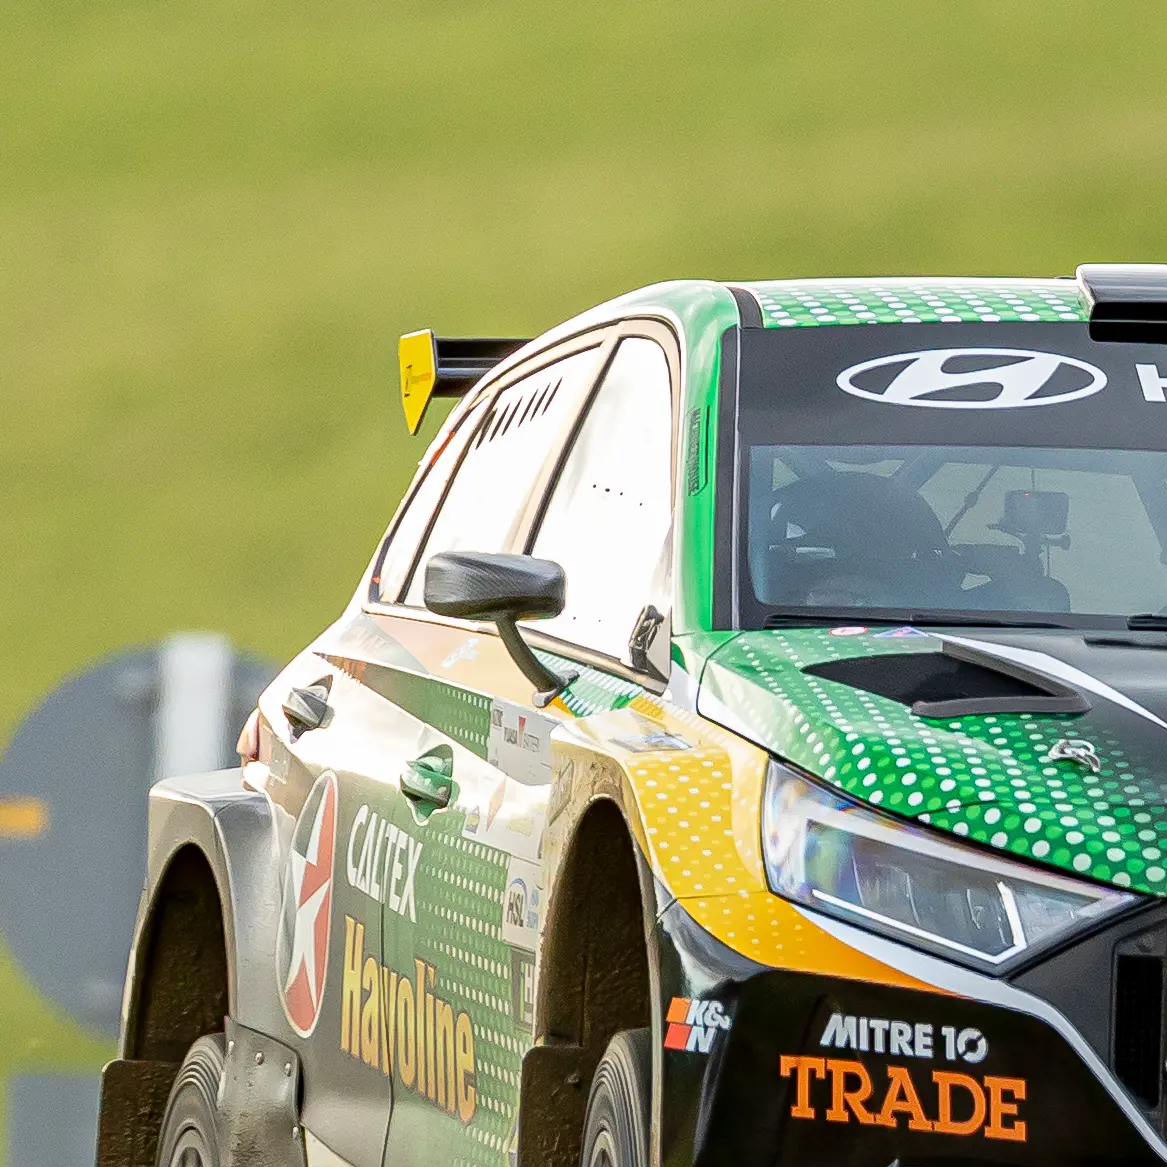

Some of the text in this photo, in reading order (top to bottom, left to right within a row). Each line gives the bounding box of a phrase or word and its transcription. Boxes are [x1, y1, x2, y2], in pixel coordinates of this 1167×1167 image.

[346, 804, 424, 924] CALTEX
[340, 914, 477, 1125] Havoline
[820, 1012, 989, 1064] MITRE 10
[779, 1055, 1028, 1143] TRADE
